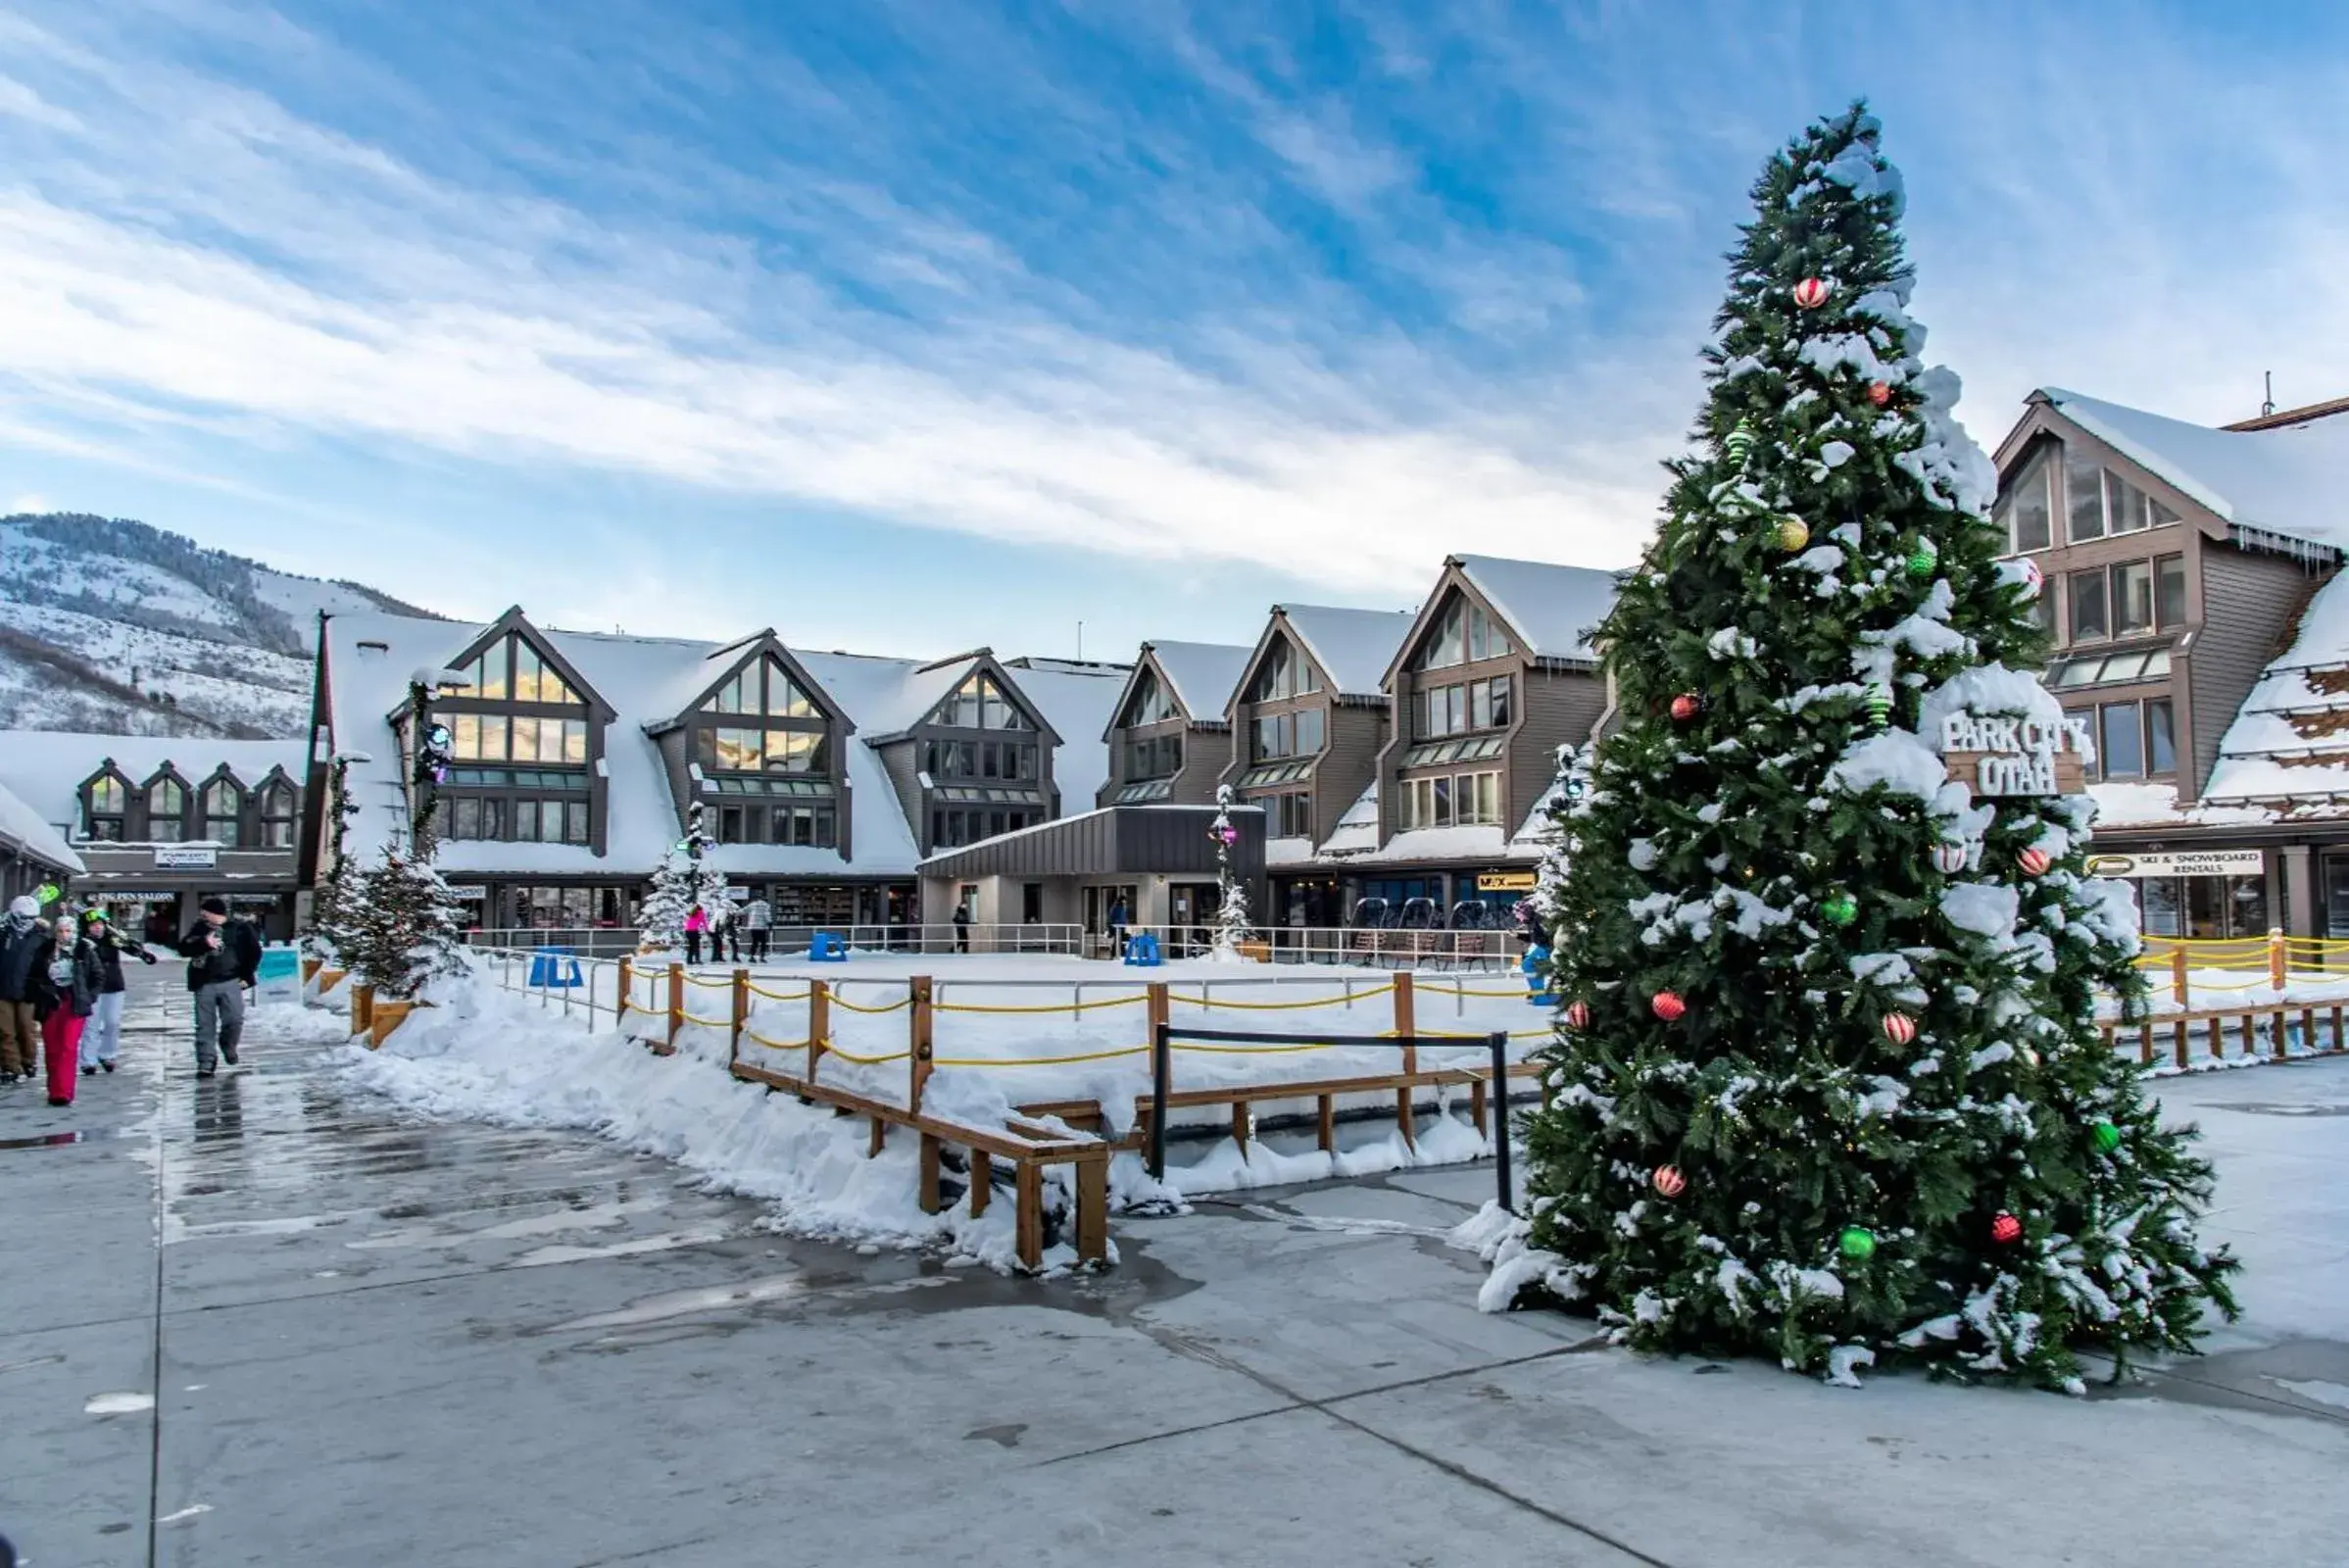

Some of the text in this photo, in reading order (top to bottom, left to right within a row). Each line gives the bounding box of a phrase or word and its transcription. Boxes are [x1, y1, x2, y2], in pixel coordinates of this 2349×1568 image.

[1941, 714, 2086, 753] PARK CITY
[1978, 754, 2058, 795] UTAH
[2173, 864, 2224, 873] RENTALS
[2177, 853, 2259, 863] SNOWBOARD
